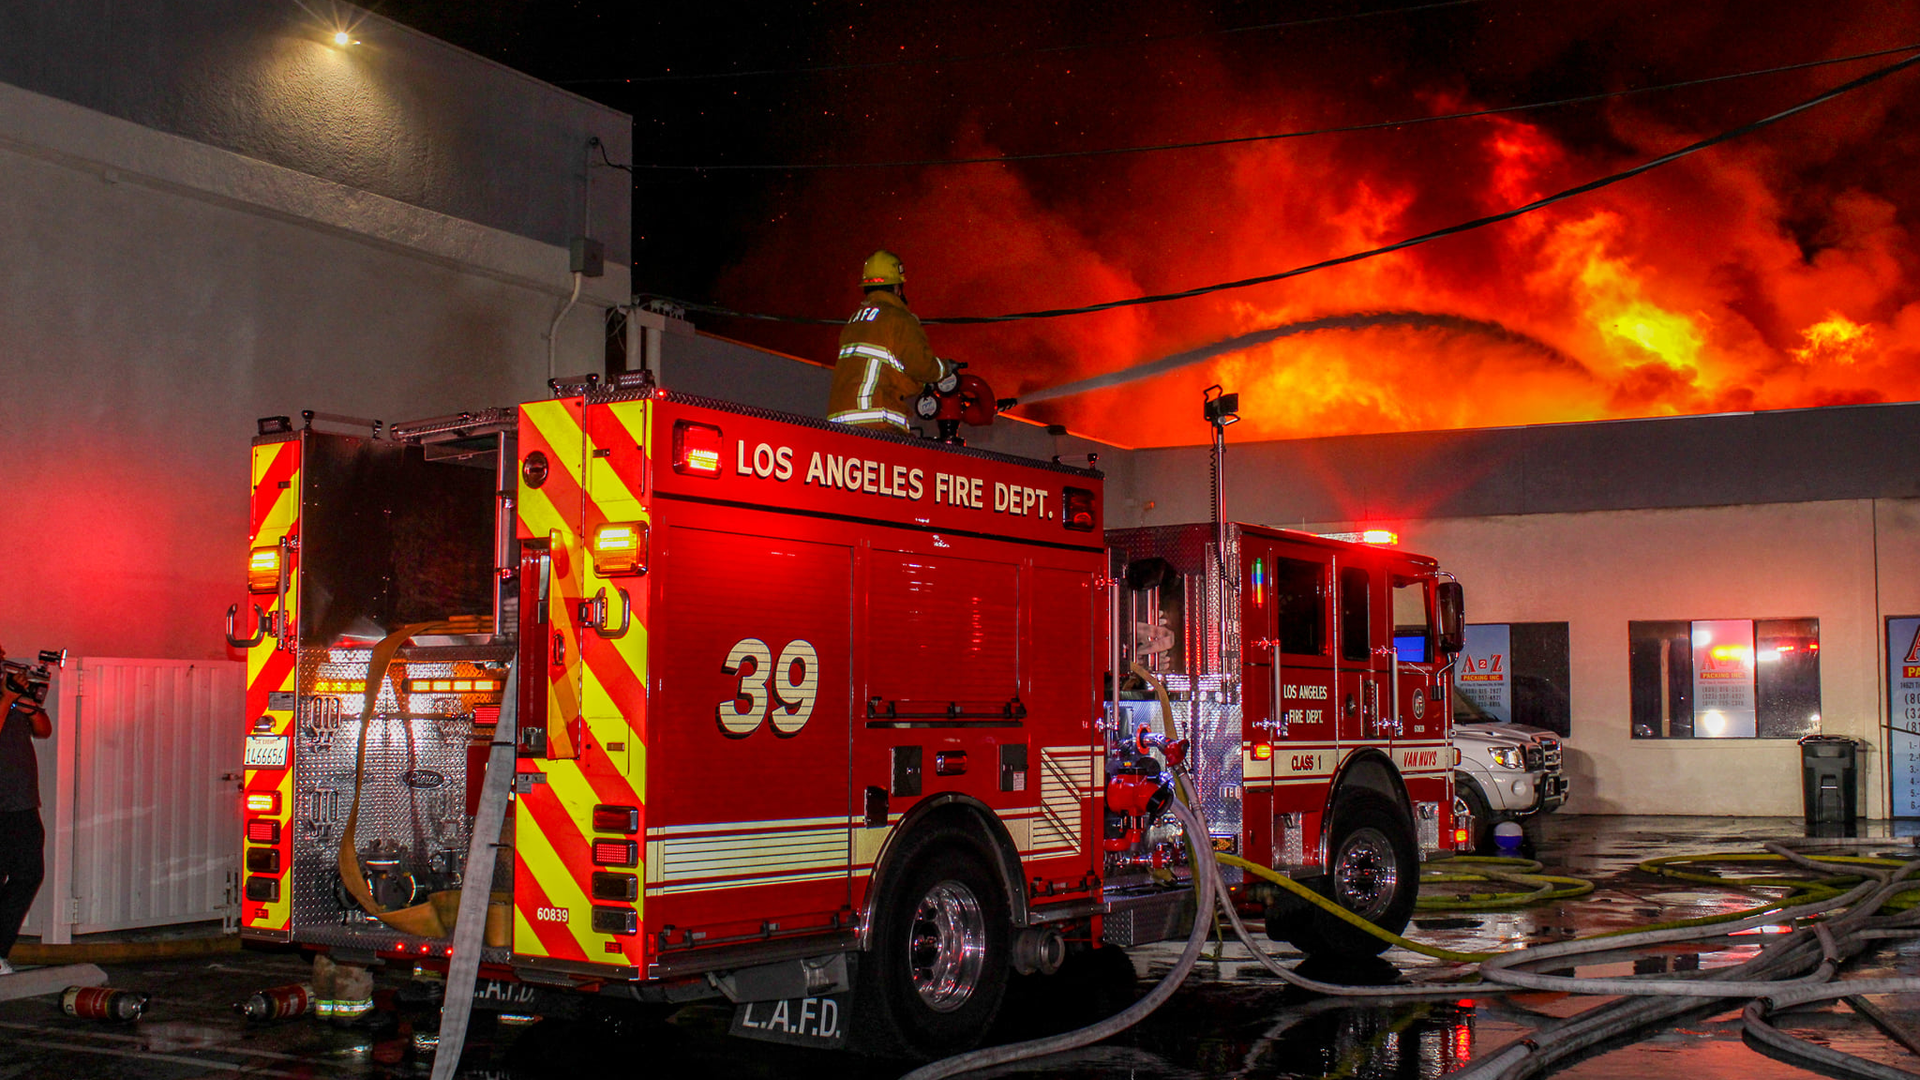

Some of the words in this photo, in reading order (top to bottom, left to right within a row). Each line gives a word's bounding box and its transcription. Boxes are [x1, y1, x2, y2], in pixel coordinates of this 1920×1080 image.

[738, 440, 793, 480] LOS
[805, 451, 924, 500] ANGELES
[935, 472, 983, 509] FIRE
[994, 482, 1053, 519] DEPT.
[1461, 654, 1476, 673] A
[1479, 659, 1487, 669] 2
[1490, 653, 1504, 673] Z
[716, 637, 819, 738] 39
[1283, 684, 1297, 699] LOS
[1298, 684, 1328, 700] ANGELES
[1289, 709, 1304, 724] FIRE
[1306, 709, 1324, 724] DEPT.
[1292, 754, 1314, 770] CLASS
[1317, 754, 1322, 770] 1
[1403, 752, 1419, 767] VAN
[1419, 750, 1437, 767] NUYS
[537, 907, 568, 922] 60839
[742, 997, 841, 1039] L.A.F.D.
